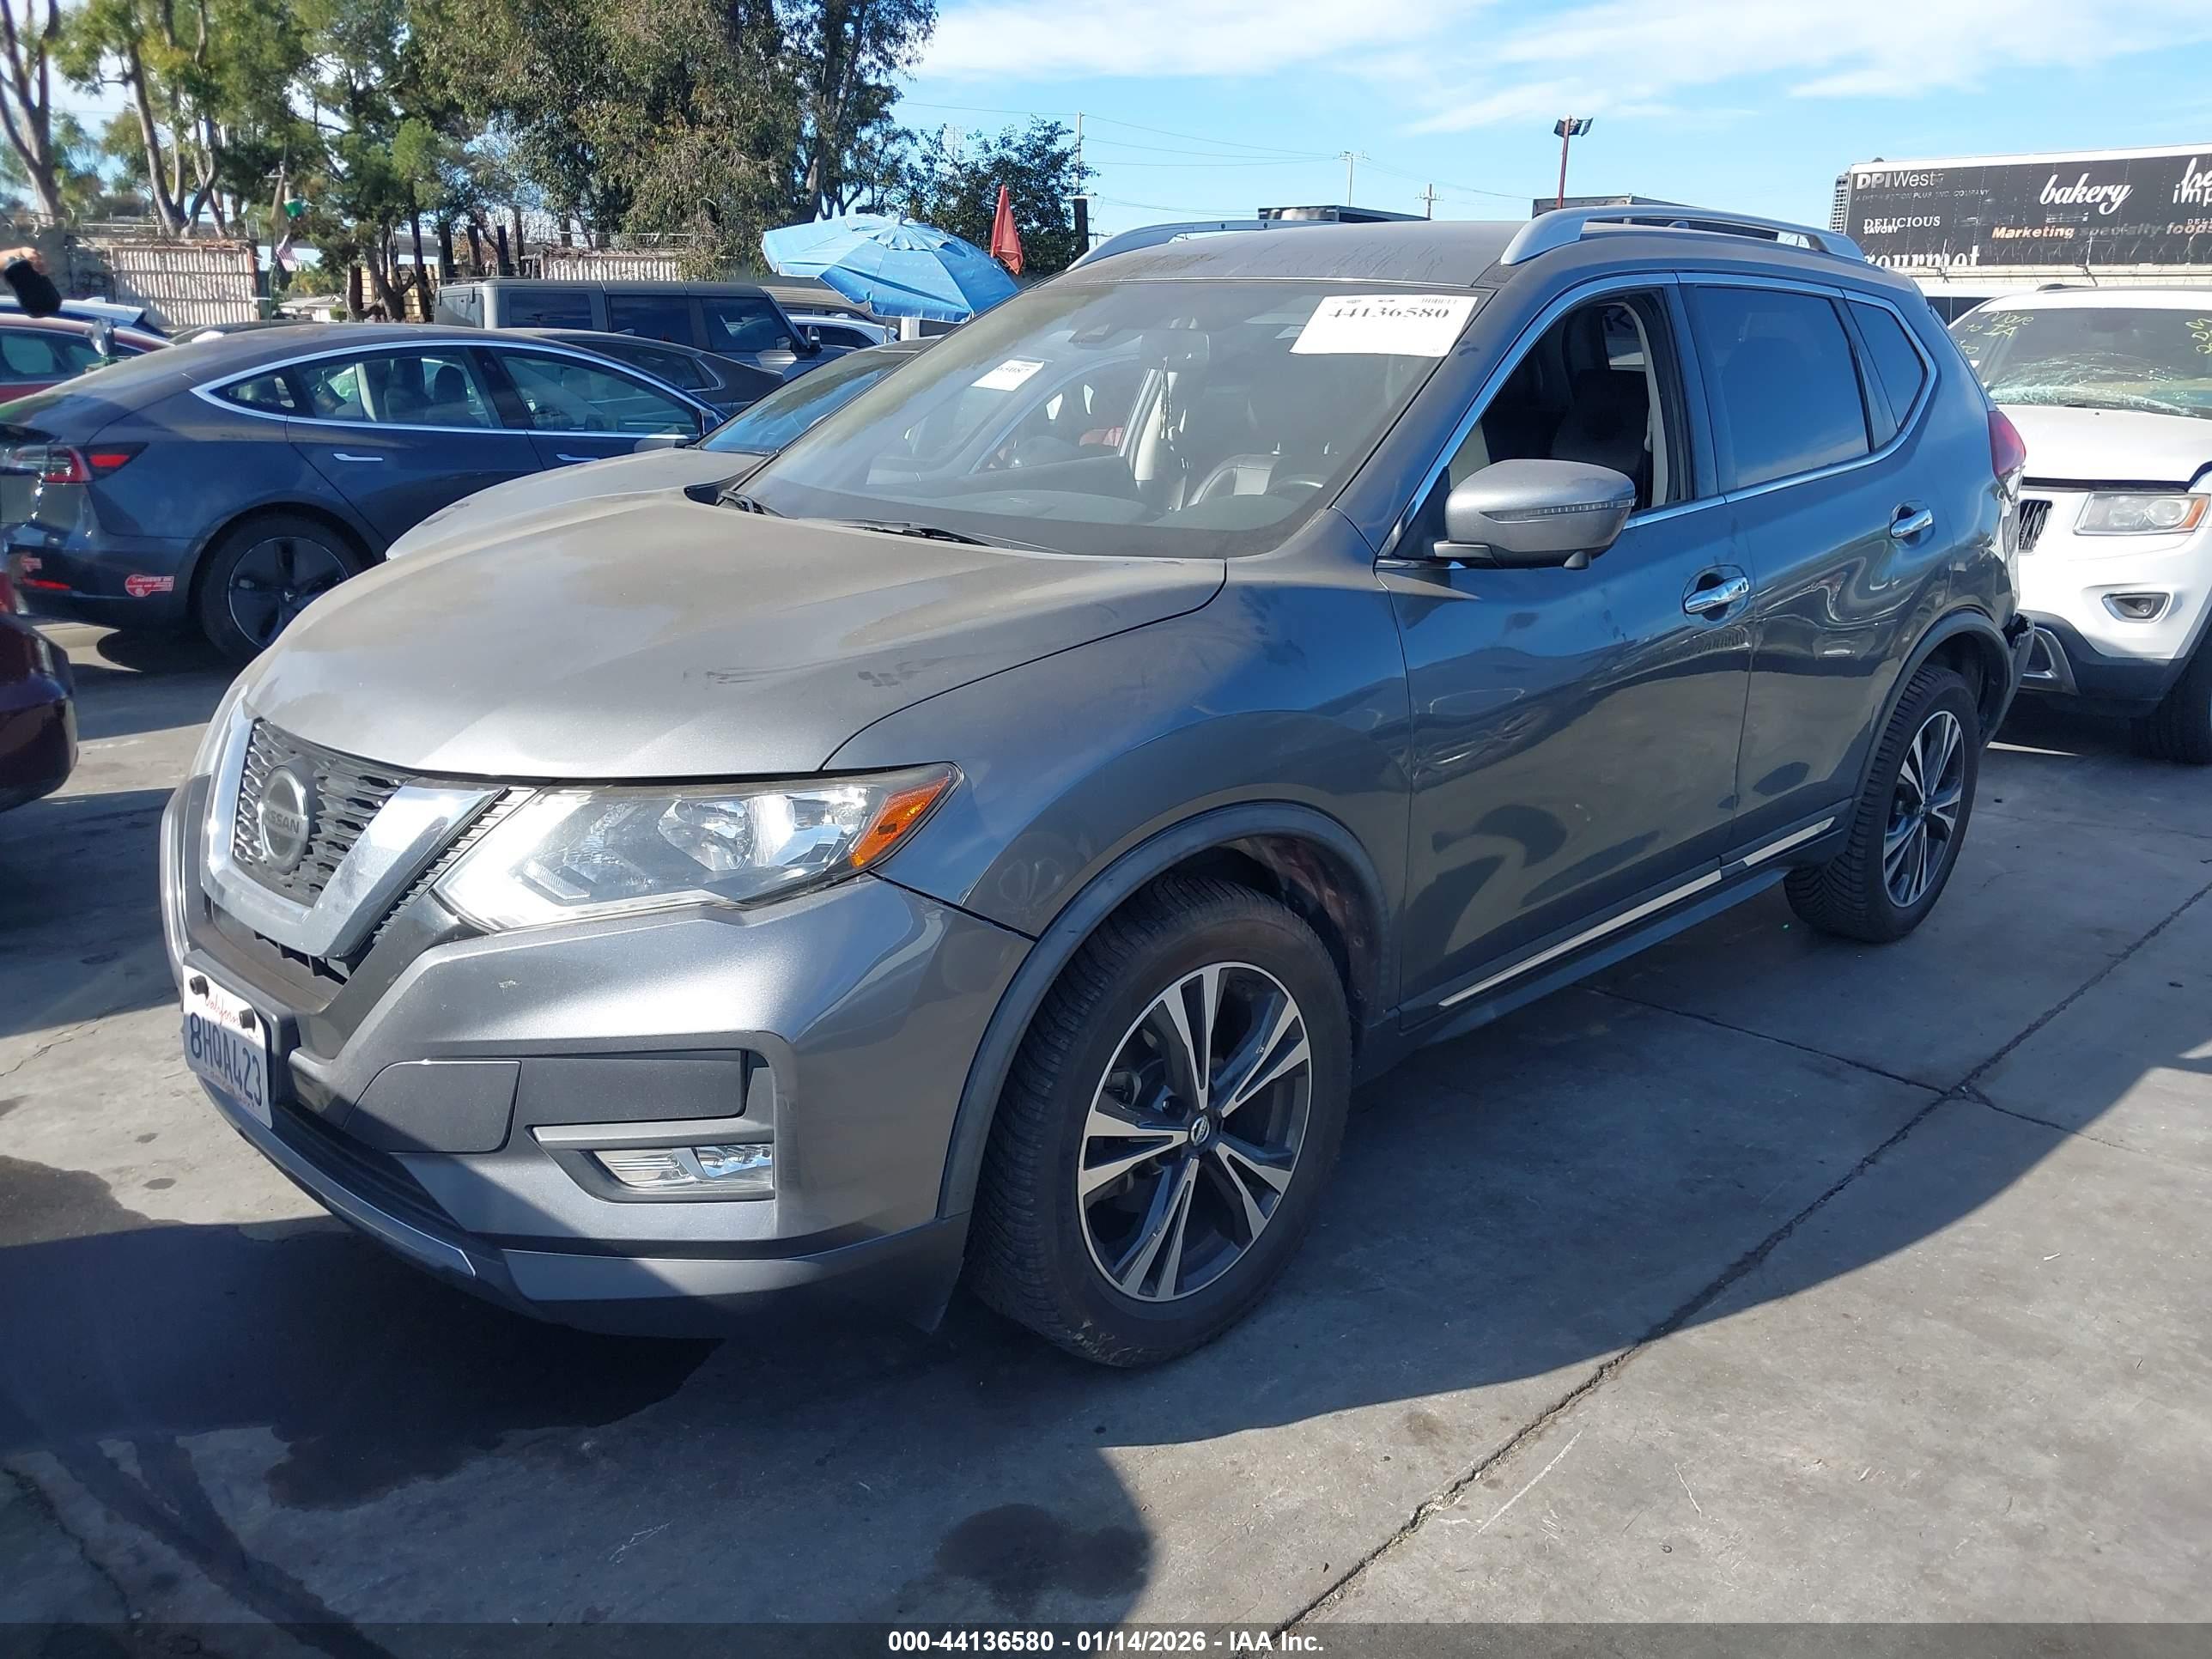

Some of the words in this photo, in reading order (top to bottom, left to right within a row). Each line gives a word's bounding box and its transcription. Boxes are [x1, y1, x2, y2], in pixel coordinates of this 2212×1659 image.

[1856, 173, 1891, 190] DPI
[1893, 171, 1936, 187] West
[1912, 191, 1933, 199] PLUS
[2039, 173, 2134, 215] bakery
[1863, 216, 1941, 228] DELICIOUS
[1863, 226, 1899, 234] SAVORY
[1992, 225, 2075, 239] Marketing
[2166, 222, 2212, 234] foods
[1864, 245, 1980, 267] ourmet
[1328, 307, 1449, 318] 44136580
